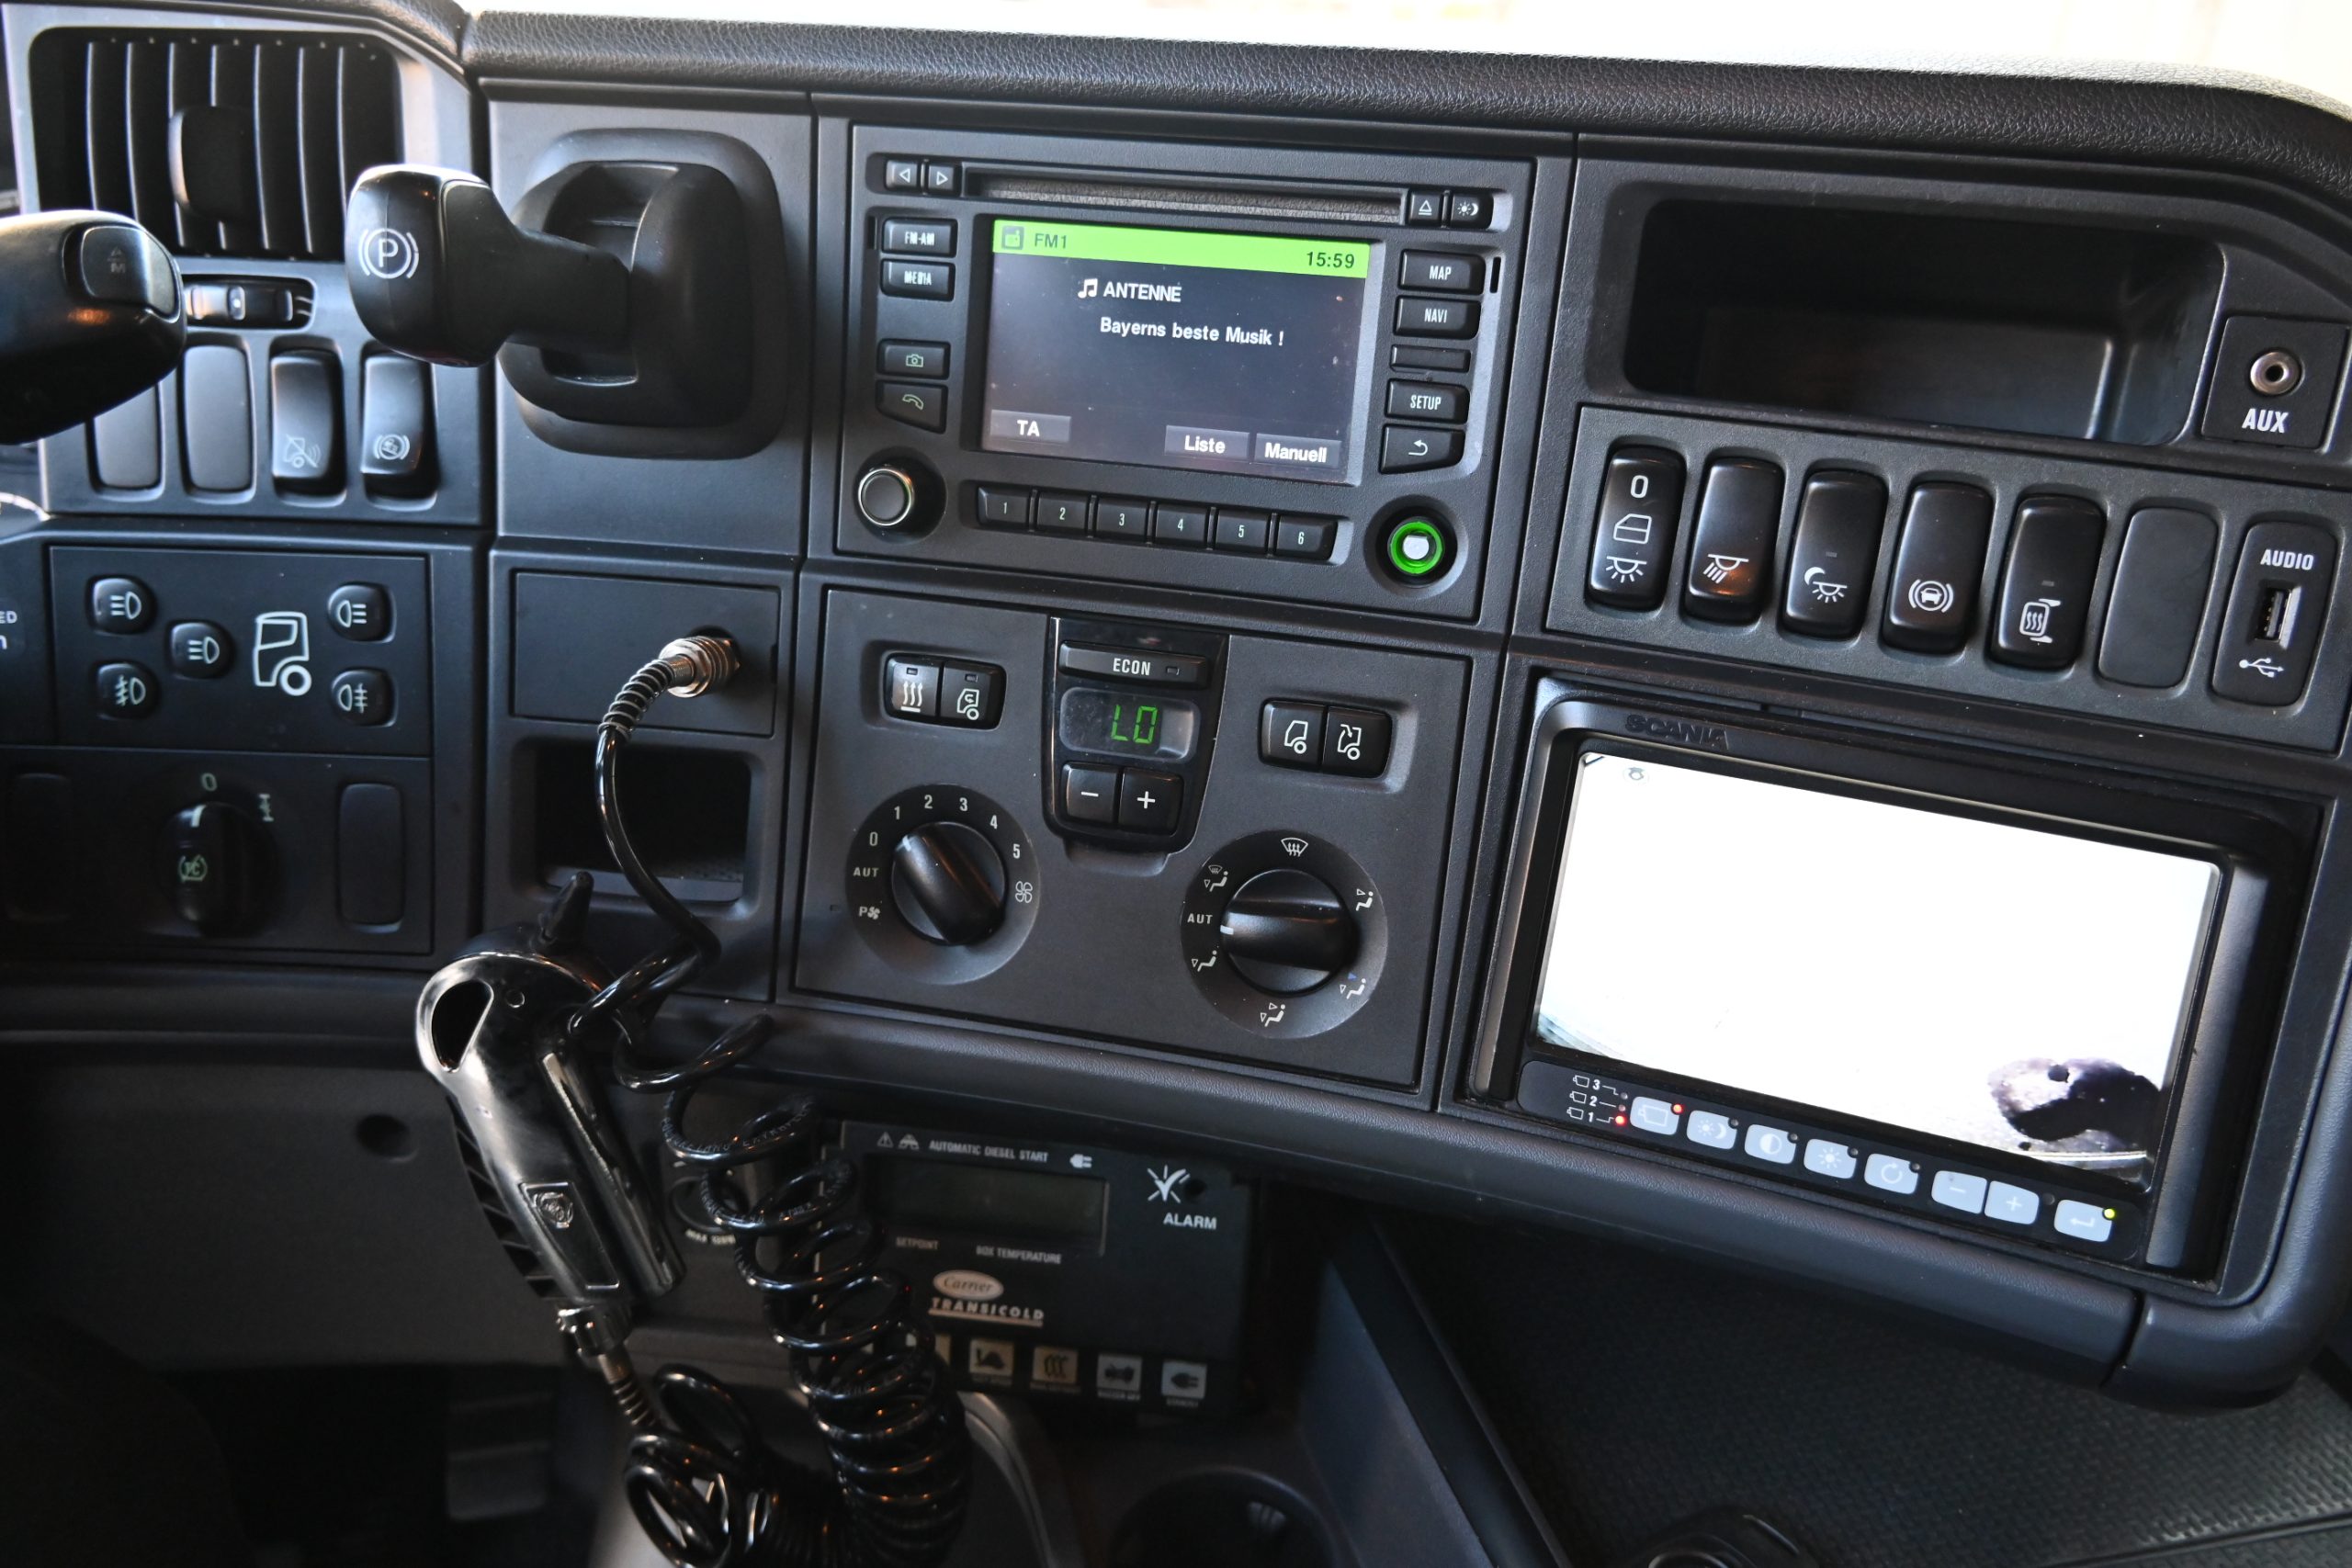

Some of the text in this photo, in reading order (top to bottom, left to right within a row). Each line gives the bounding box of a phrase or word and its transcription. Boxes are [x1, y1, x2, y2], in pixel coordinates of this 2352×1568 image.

[904, 231, 935, 246] FM-AM
[1034, 232, 1068, 249] FM1
[1306, 251, 1355, 269] 15:59
[904, 271, 933, 287] MEDIA
[1429, 265, 1452, 281] MAP
[1102, 281, 1182, 302] ANTENNE
[1423, 308, 1448, 324] NAVI
[1100, 316, 1167, 337] Bayerns
[1171, 322, 1220, 342] beste
[1225, 326, 1272, 345] Musik
[1409, 394, 1442, 411] SETUP
[1016, 419, 1041, 437] TA
[2241, 407, 2290, 434] AUX
[1184, 434, 1226, 454] Liste
[1264, 442, 1328, 463] Manuell
[1002, 502, 1008, 514] 1
[1058, 507, 1066, 520] 2
[1118, 513, 1125, 526] 3
[1177, 518, 1183, 532] 4
[1238, 525, 1245, 538] 5
[1298, 531, 1305, 545] 6
[2259, 548, 2314, 571] AUDIO
[1113, 658, 1151, 677] ECON
[1624, 714, 1730, 751] SCANIA
[924, 795, 933, 809] 2
[959, 797, 968, 812] 3
[894, 807, 901, 820] 1
[989, 815, 998, 829] 4
[869, 831, 878, 846] 0
[1012, 844, 1021, 860] 5
[853, 866, 879, 877] AUT
[1187, 913, 1213, 925] AUT
[1592, 1079, 1600, 1091] 3
[1589, 1095, 1598, 1107] 2
[1588, 1112, 1594, 1123] 1
[929, 1139, 1048, 1162] AUTOMATIC DIESEL START
[1162, 1213, 1217, 1230] ALARM
[896, 1236, 939, 1250] SETPOINT
[976, 1245, 1062, 1265] BOX TEMPERATURE
[931, 1296, 1045, 1320] TRANSICOLD
